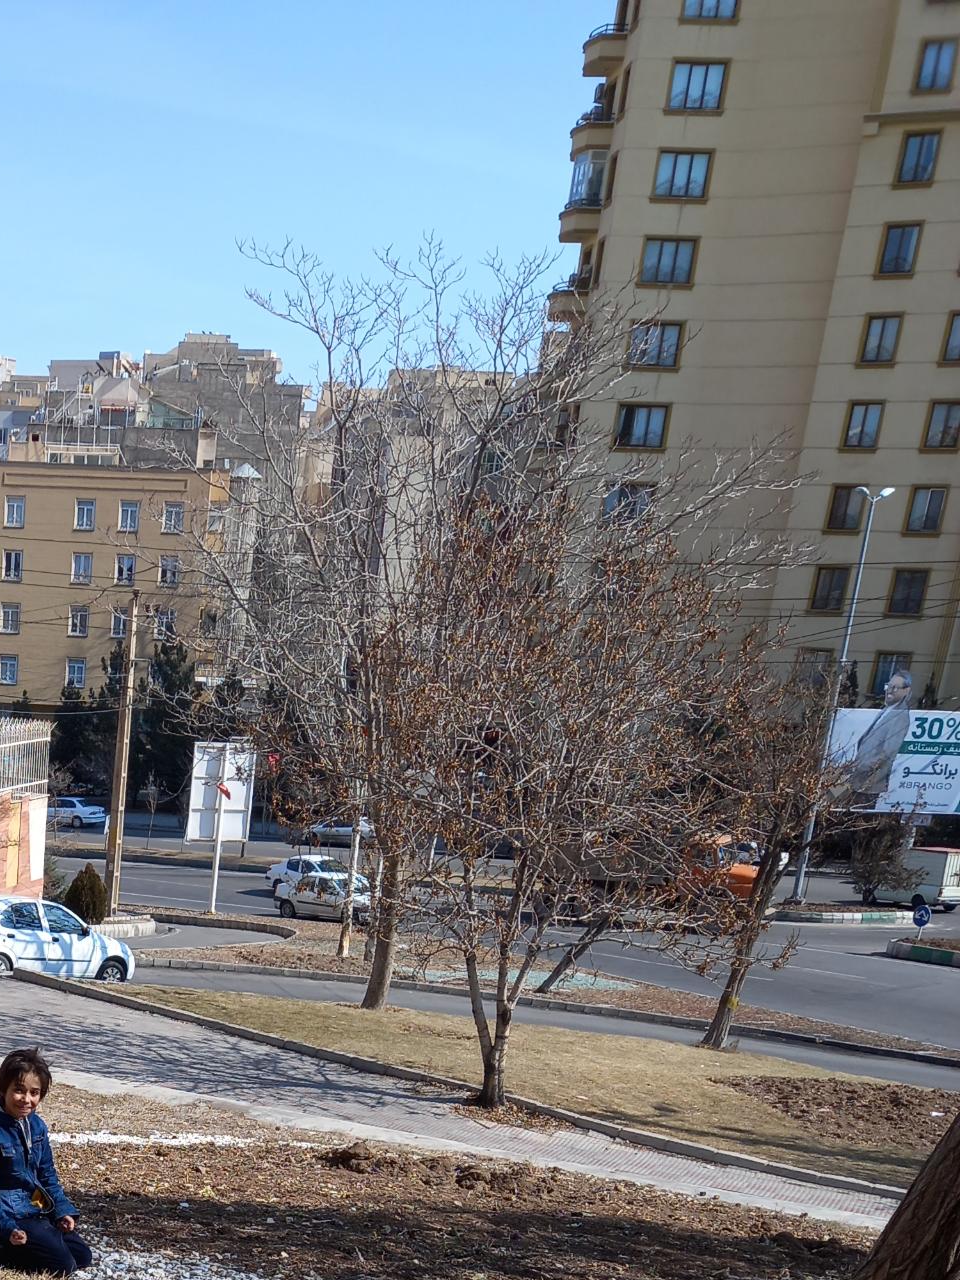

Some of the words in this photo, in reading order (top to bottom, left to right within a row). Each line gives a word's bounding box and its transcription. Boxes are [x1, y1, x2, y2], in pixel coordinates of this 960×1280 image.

[911, 716, 960, 741] 30%
[907, 743, 943, 755] زمستانه
[902, 760, 958, 780] برانگو
[906, 781, 952, 791] BRANGO
